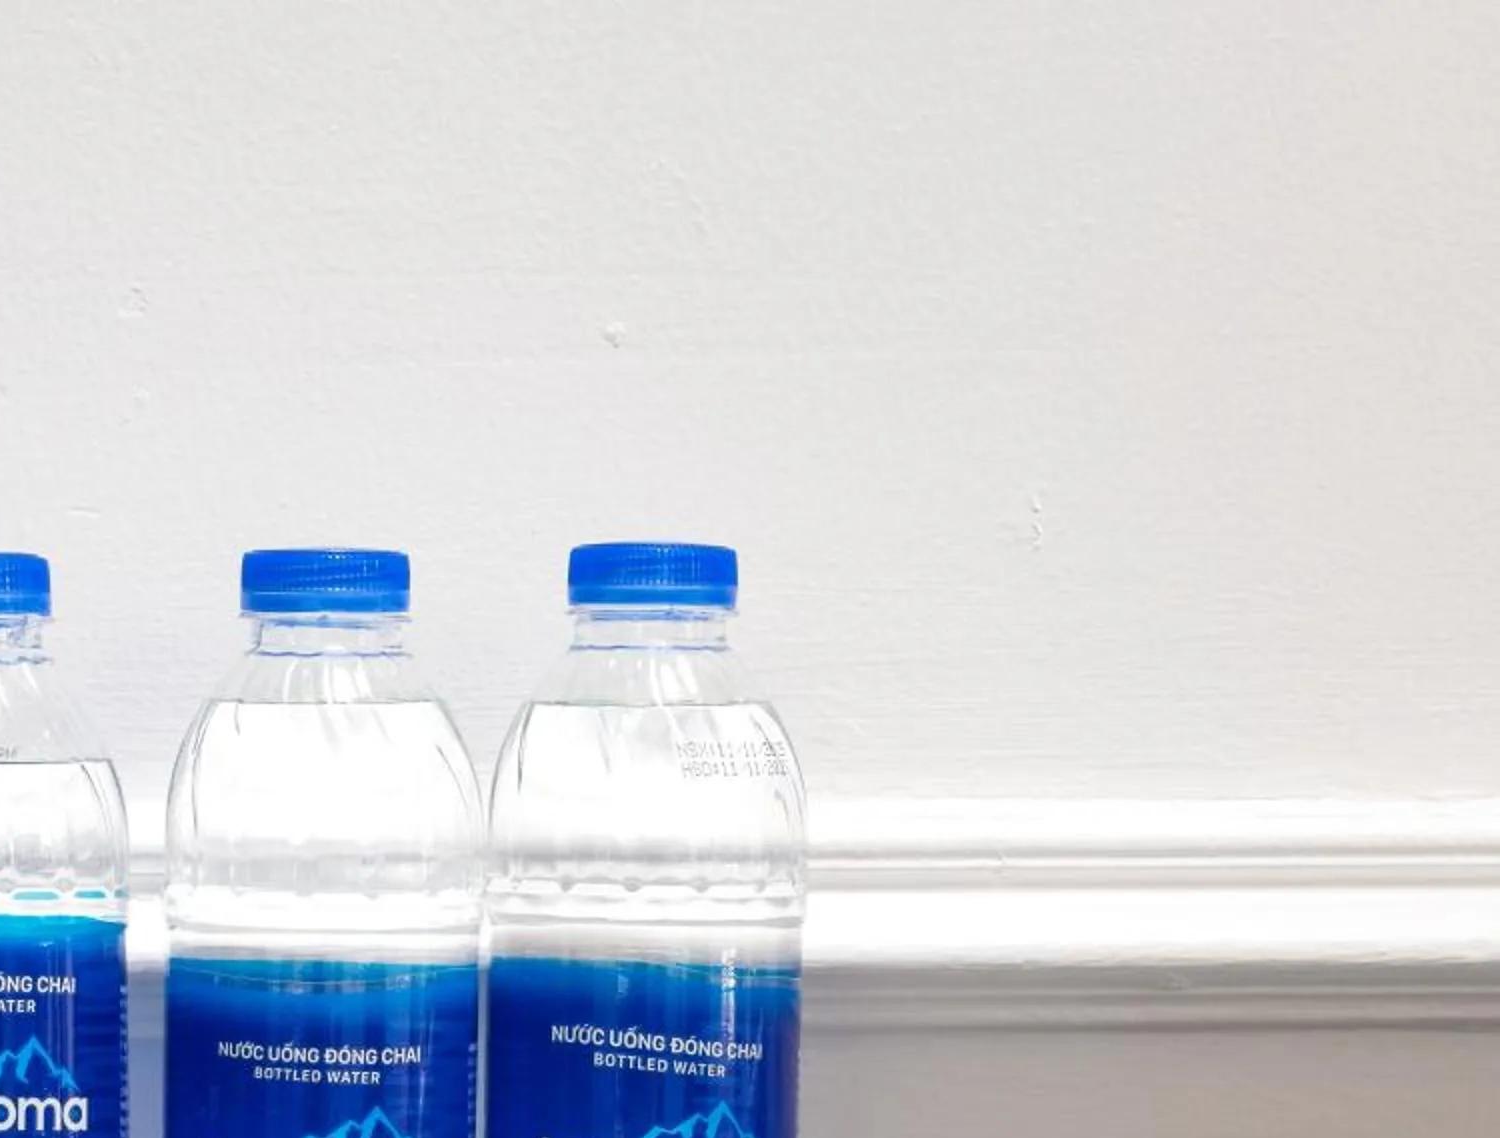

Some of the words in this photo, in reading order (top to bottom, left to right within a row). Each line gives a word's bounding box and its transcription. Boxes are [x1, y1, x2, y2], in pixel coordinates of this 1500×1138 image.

[37, 975, 76, 993] CHAI
[218, 1041, 263, 1061] NƯỚC
[268, 1042, 319, 1063] UỐNG
[324, 1043, 377, 1065] ĐÓNG
[381, 1046, 420, 1064] CHAI
[551, 1024, 605, 1046] NƯỚC
[609, 1026, 665, 1051] UỐNG
[670, 1036, 723, 1058] ĐÓNG
[727, 1041, 763, 1059] CHAI
[254, 1067, 320, 1083] BOTTLED
[327, 1071, 380, 1085] WATER
[594, 1052, 668, 1073] BOTTLED
[673, 1060, 726, 1078] WATER
